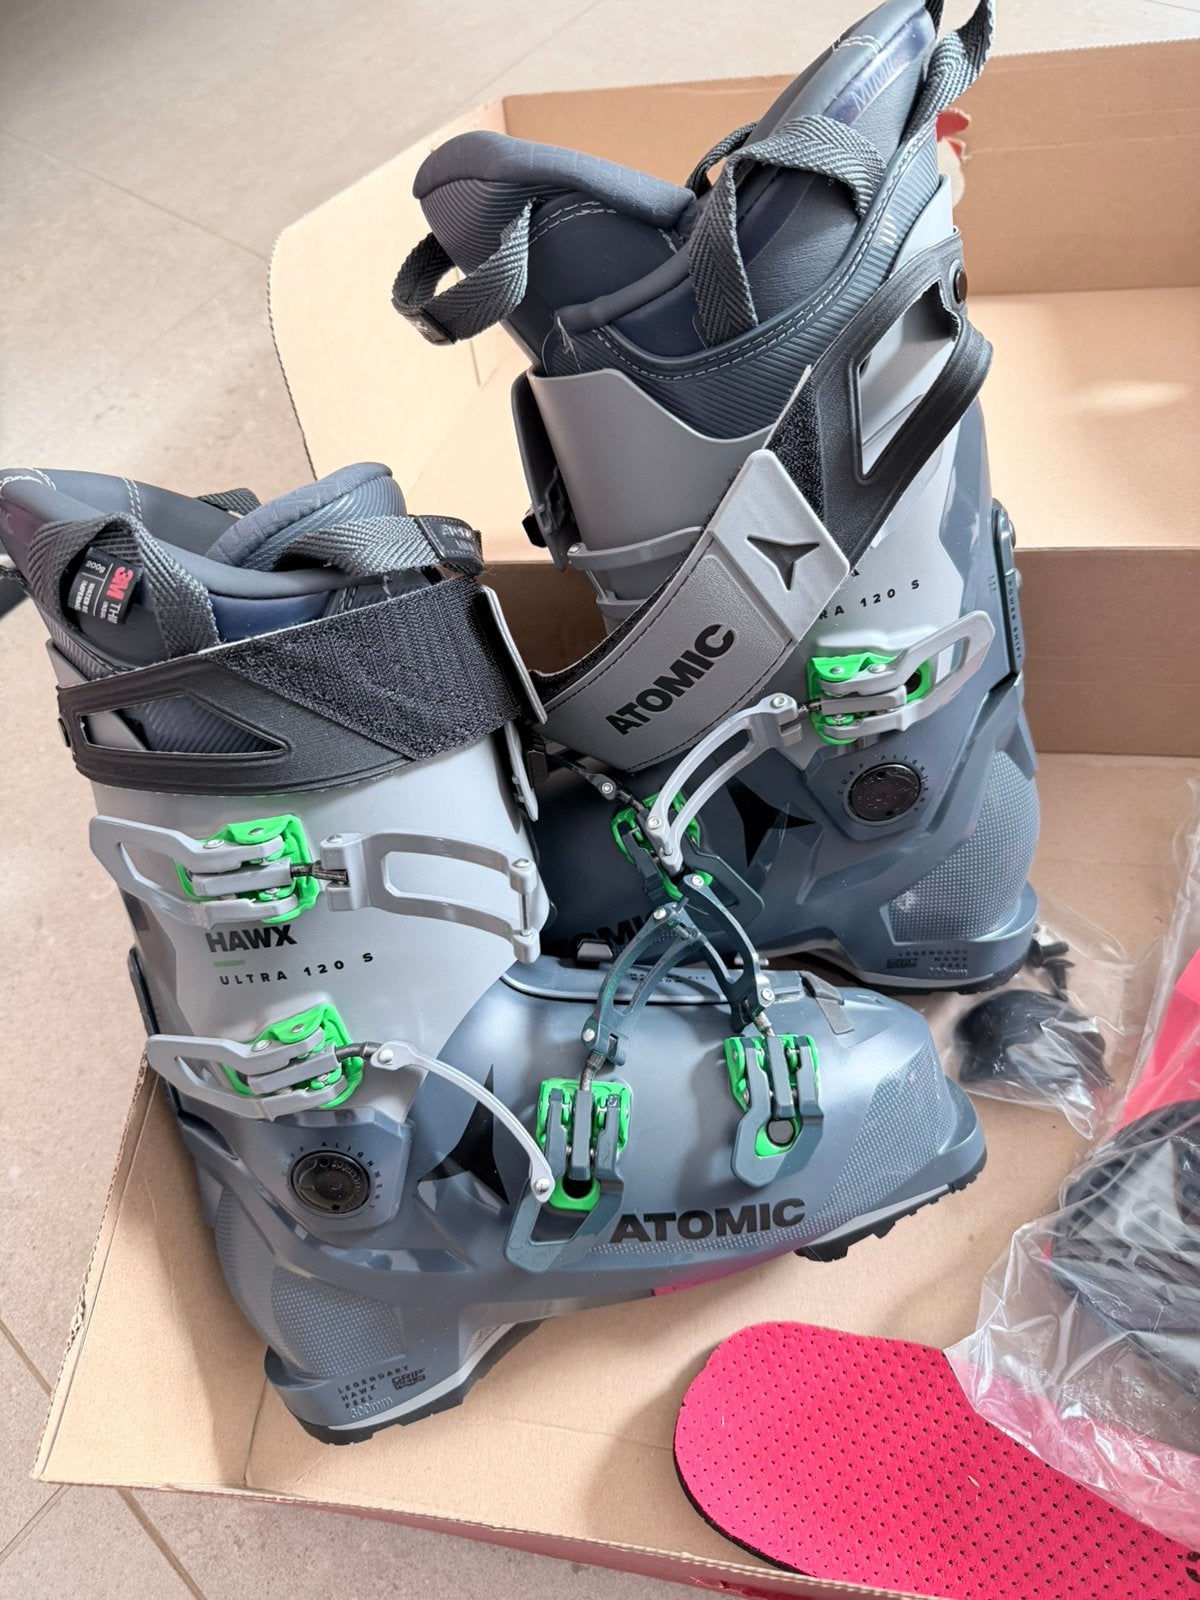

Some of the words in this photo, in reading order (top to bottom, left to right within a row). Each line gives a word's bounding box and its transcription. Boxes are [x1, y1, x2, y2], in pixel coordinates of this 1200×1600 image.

[106, 567, 134, 600] 3M
[860, 588, 896, 608] 120
[911, 579, 920, 590] S
[605, 624, 735, 735] ATOMIC
[205, 924, 298, 953] HAWX
[219, 970, 287, 986] ULTRA
[304, 960, 344, 977] 120
[363, 952, 373, 963] S
[610, 1198, 805, 1243] ATOMIC
[337, 1365, 408, 1393] LEGENDARY
[341, 1384, 376, 1402] HAWX
